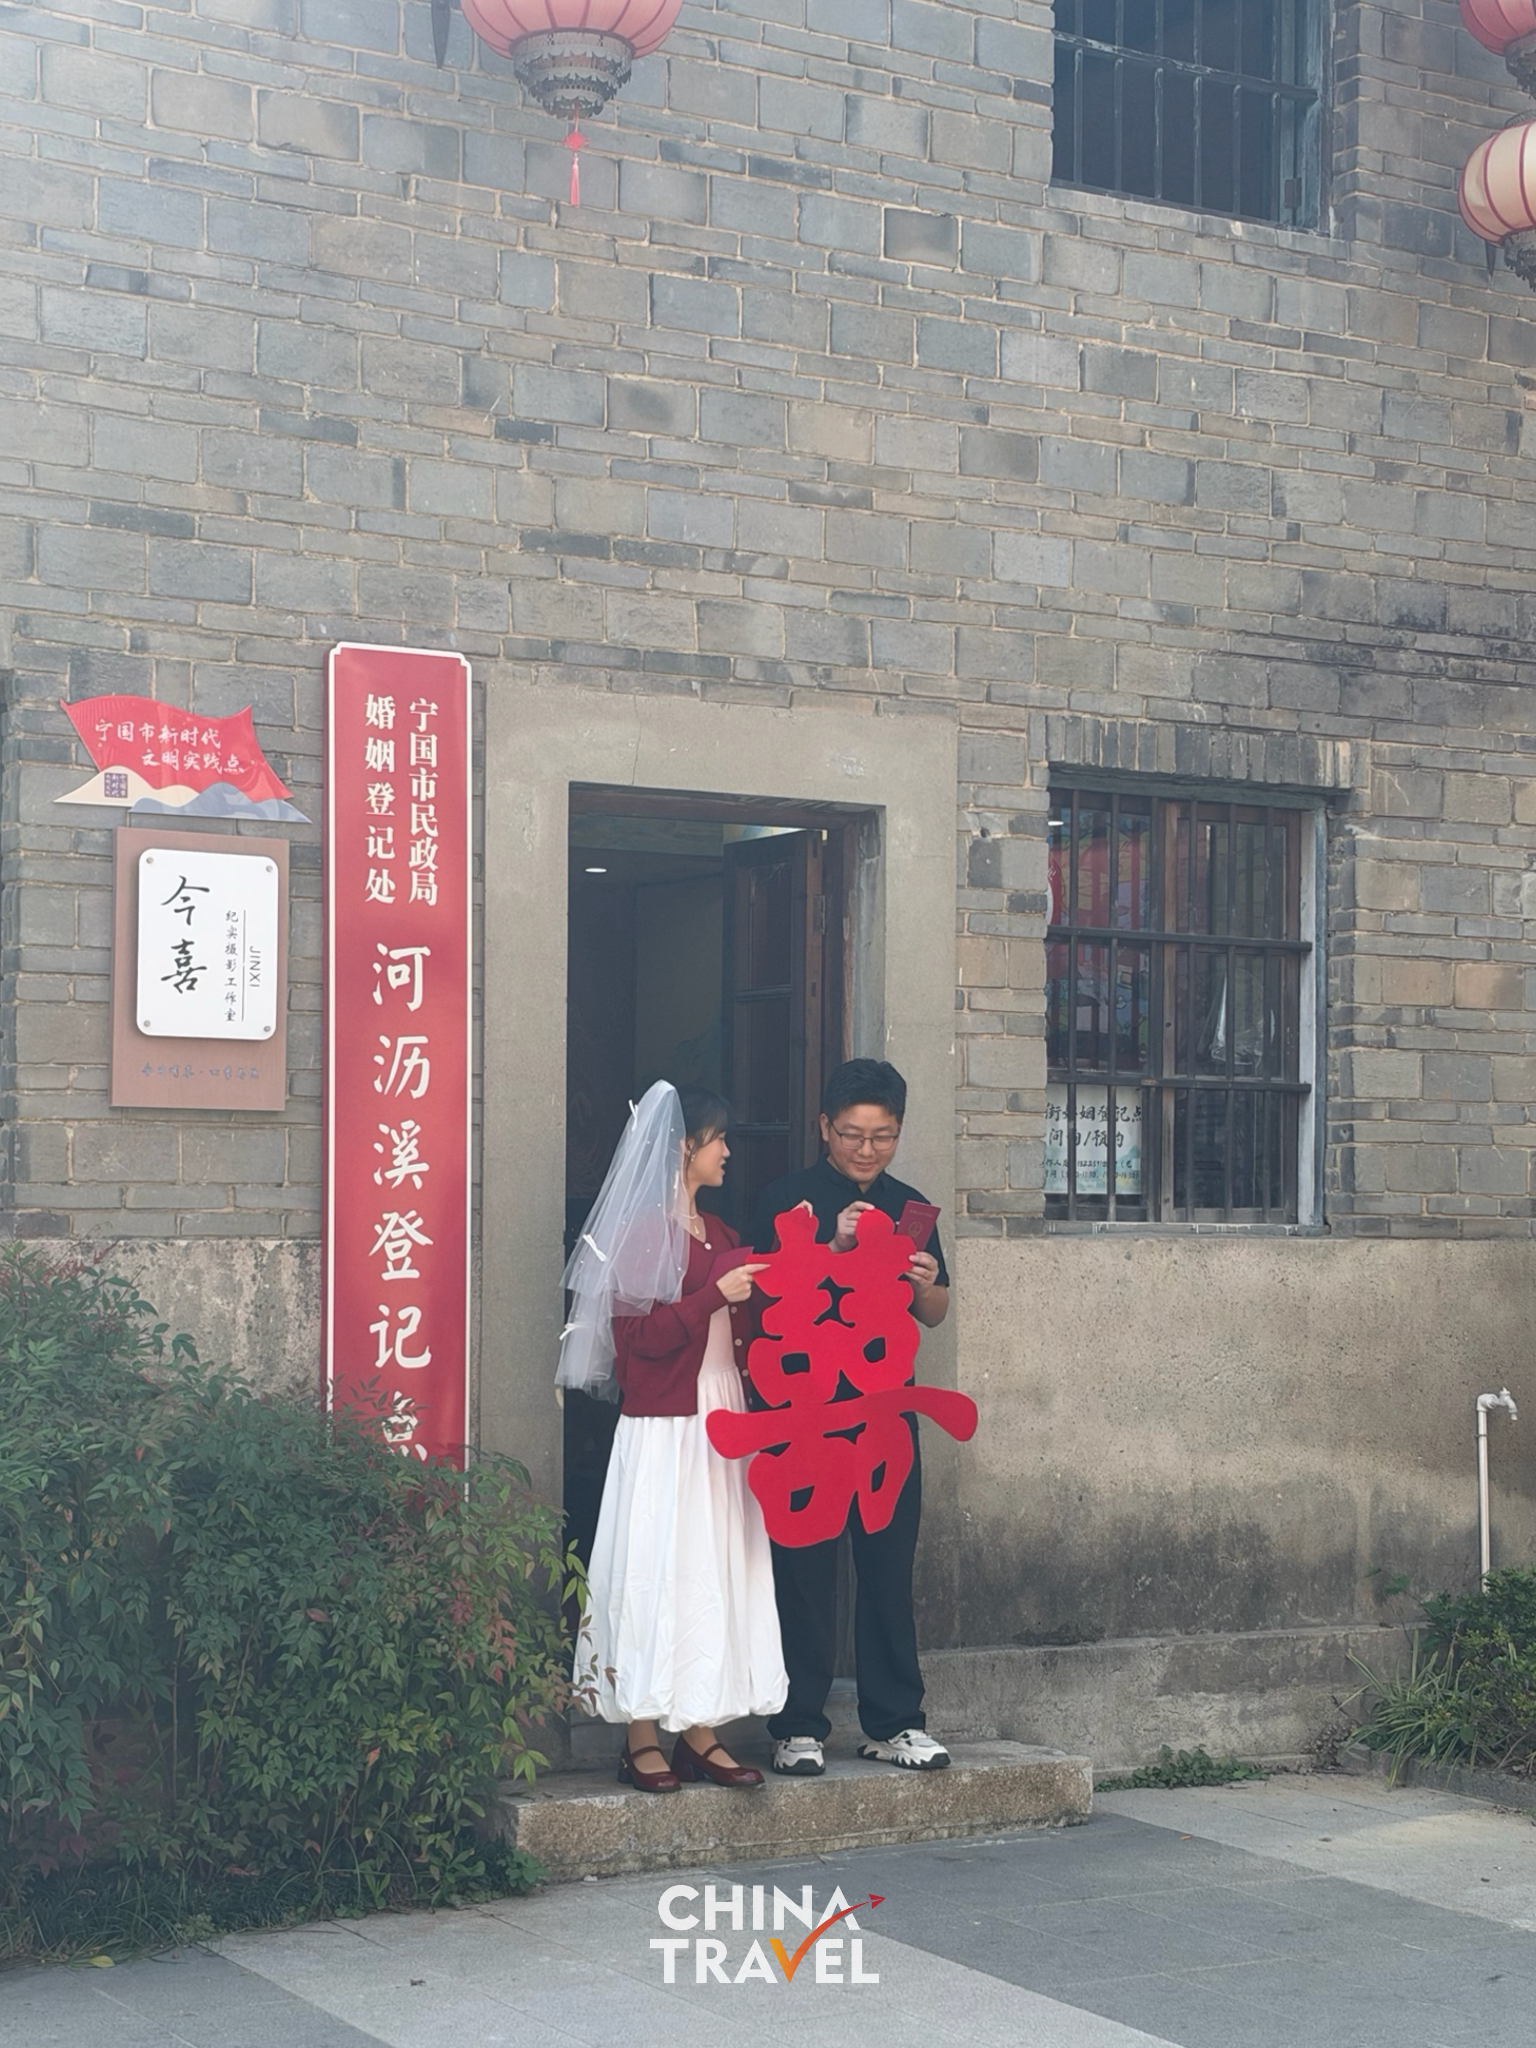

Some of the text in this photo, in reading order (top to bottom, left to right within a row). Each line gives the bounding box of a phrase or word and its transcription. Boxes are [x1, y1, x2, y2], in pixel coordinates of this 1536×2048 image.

[94, 718, 222, 749] 宁国市新时代
[141, 748, 245, 774] 文明实践点
[364, 693, 397, 905] 婚姻登记处
[408, 697, 439, 907] 宁国市民政局
[160, 874, 210, 994] 今喜
[224, 910, 239, 1022] 纪实摄影工作室
[249, 945, 261, 988] JINXI
